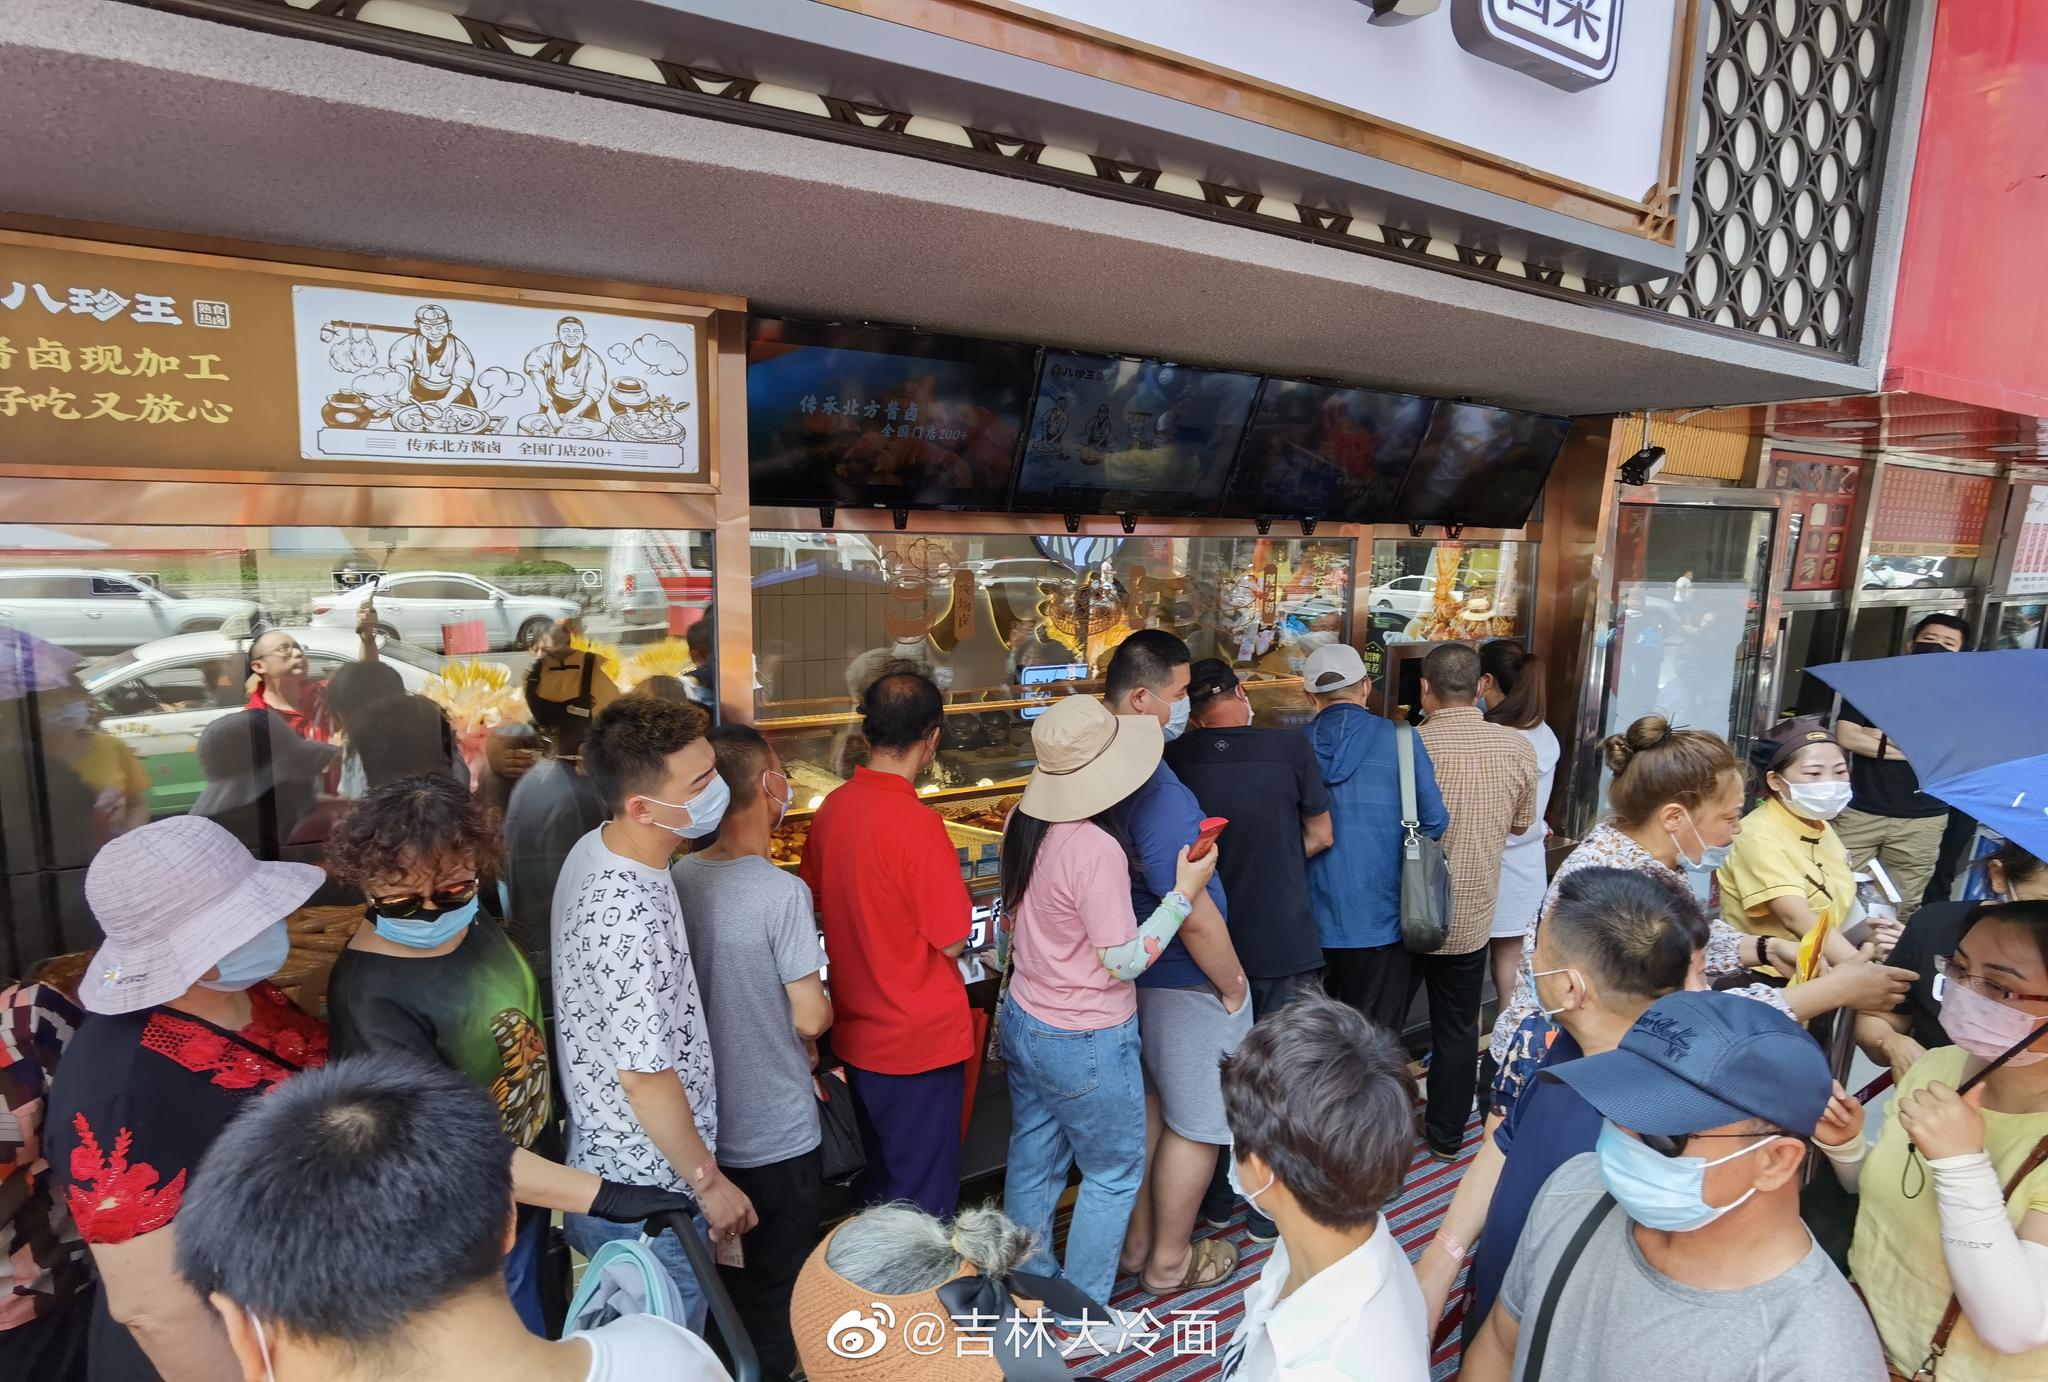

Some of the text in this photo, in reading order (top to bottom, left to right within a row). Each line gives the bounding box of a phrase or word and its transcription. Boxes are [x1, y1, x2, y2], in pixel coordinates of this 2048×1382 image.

[1, 281, 183, 326] 八珍王
[799, 394, 919, 422] 传承北方酱卤
[406, 438, 613, 457] 传承北方酱卤 全国门店200+
